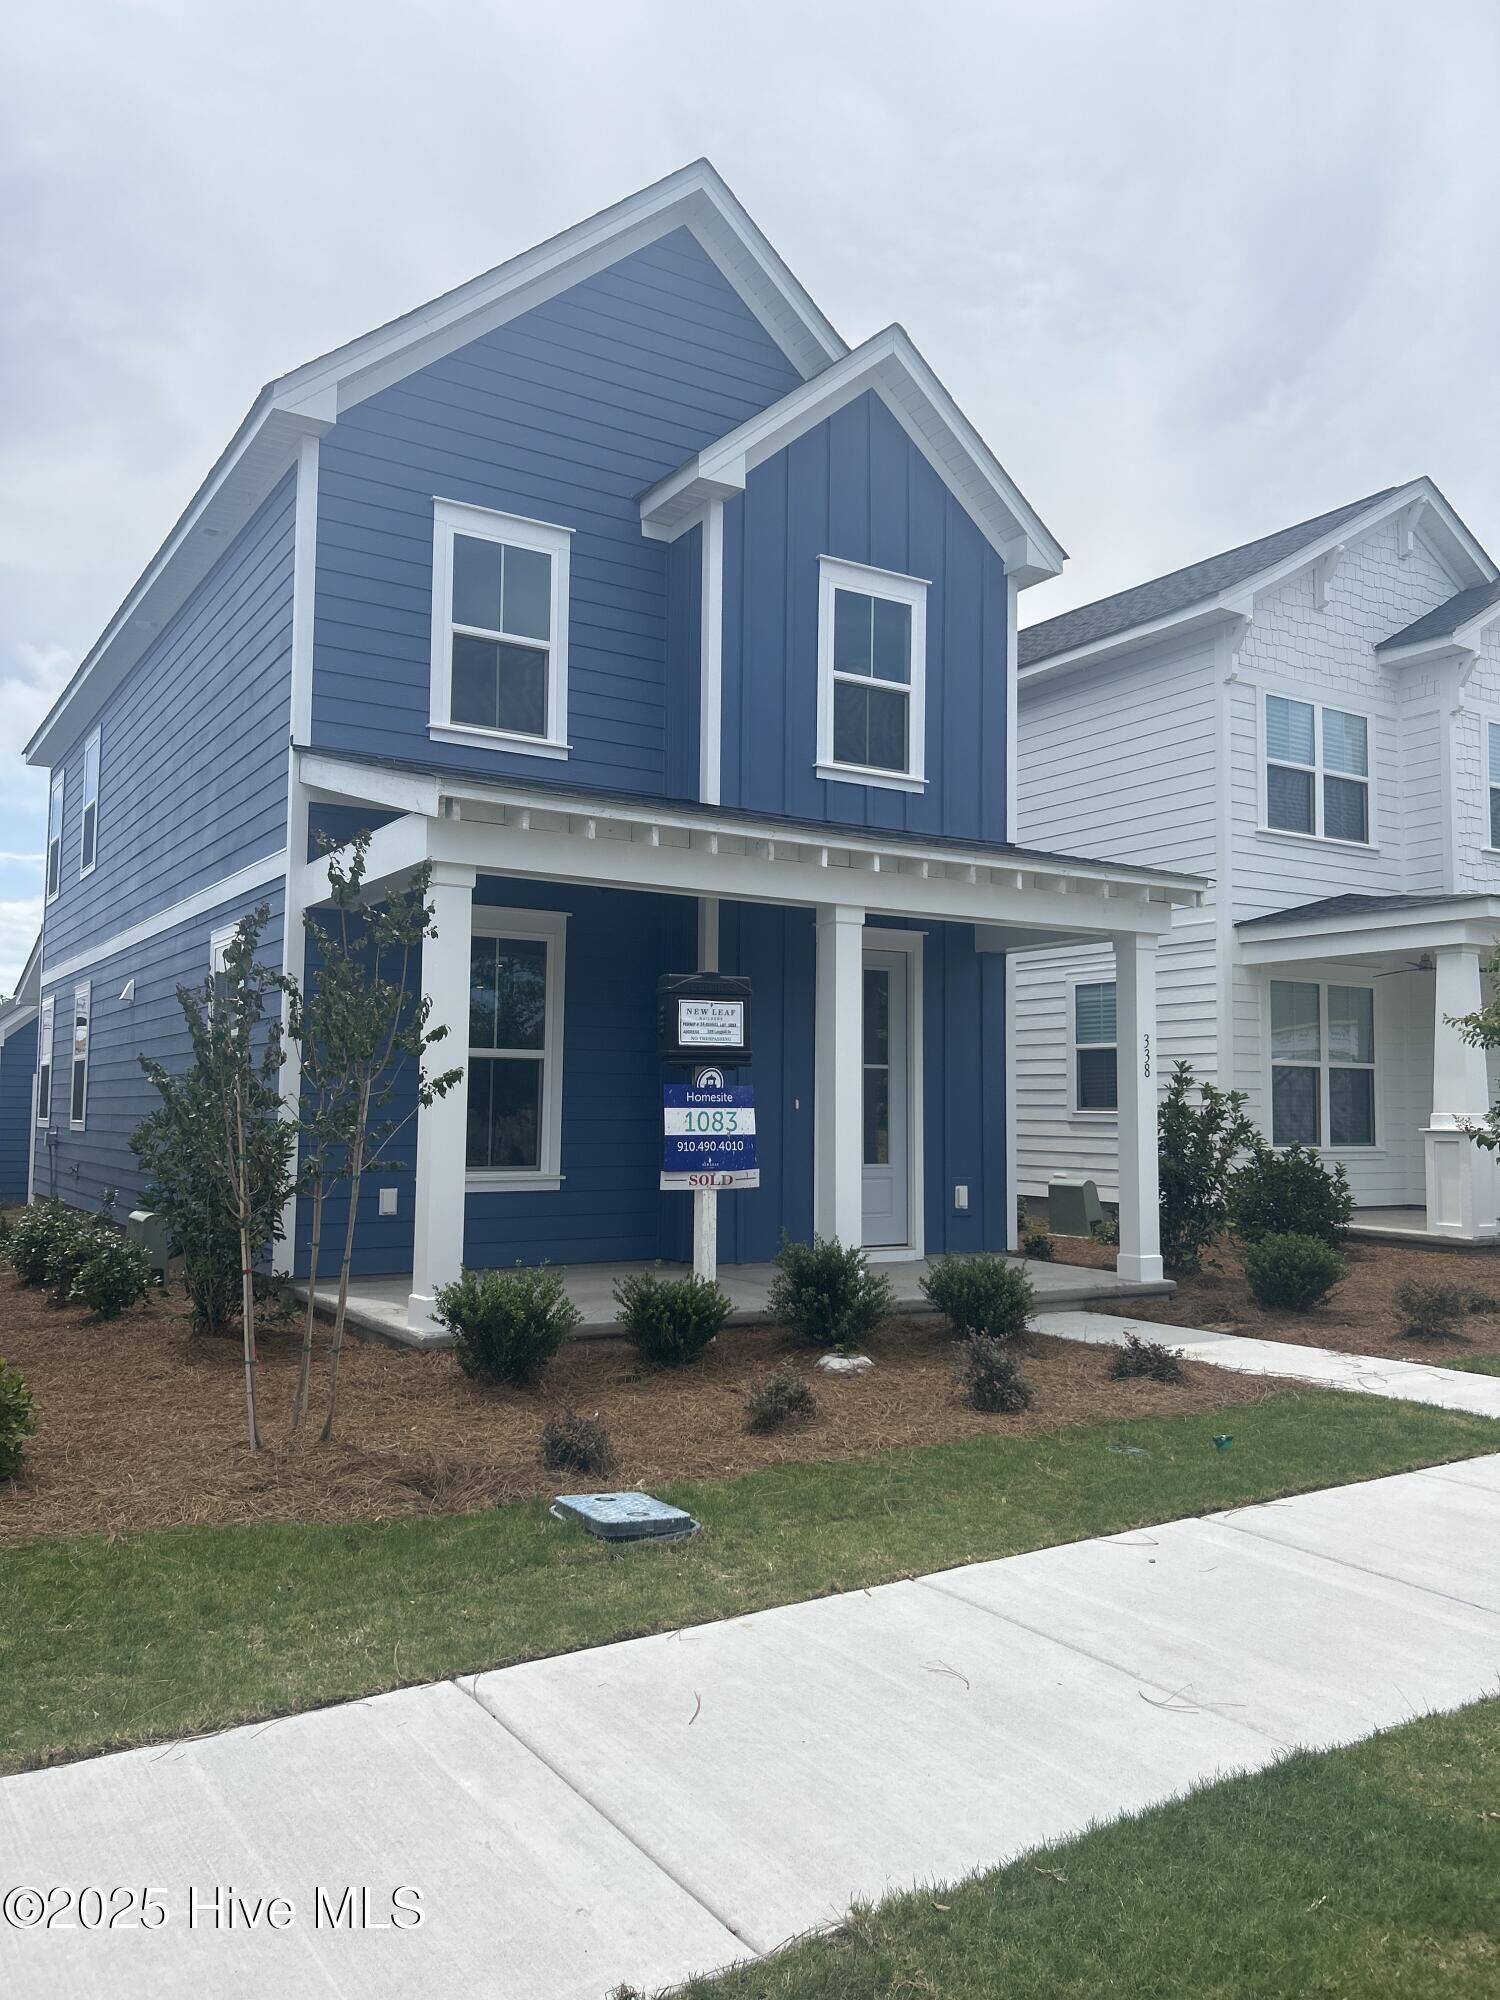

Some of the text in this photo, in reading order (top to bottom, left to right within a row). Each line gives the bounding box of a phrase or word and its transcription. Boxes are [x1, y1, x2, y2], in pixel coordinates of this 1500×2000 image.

[686, 1008, 708, 1016] NEW
[1143, 1033, 1151, 1078] 338
[686, 1091, 733, 1103] Homesite
[685, 1111, 738, 1132] 1083
[677, 1141, 744, 1152] 910.490.4010
[688, 1174, 734, 1186] SOLD
